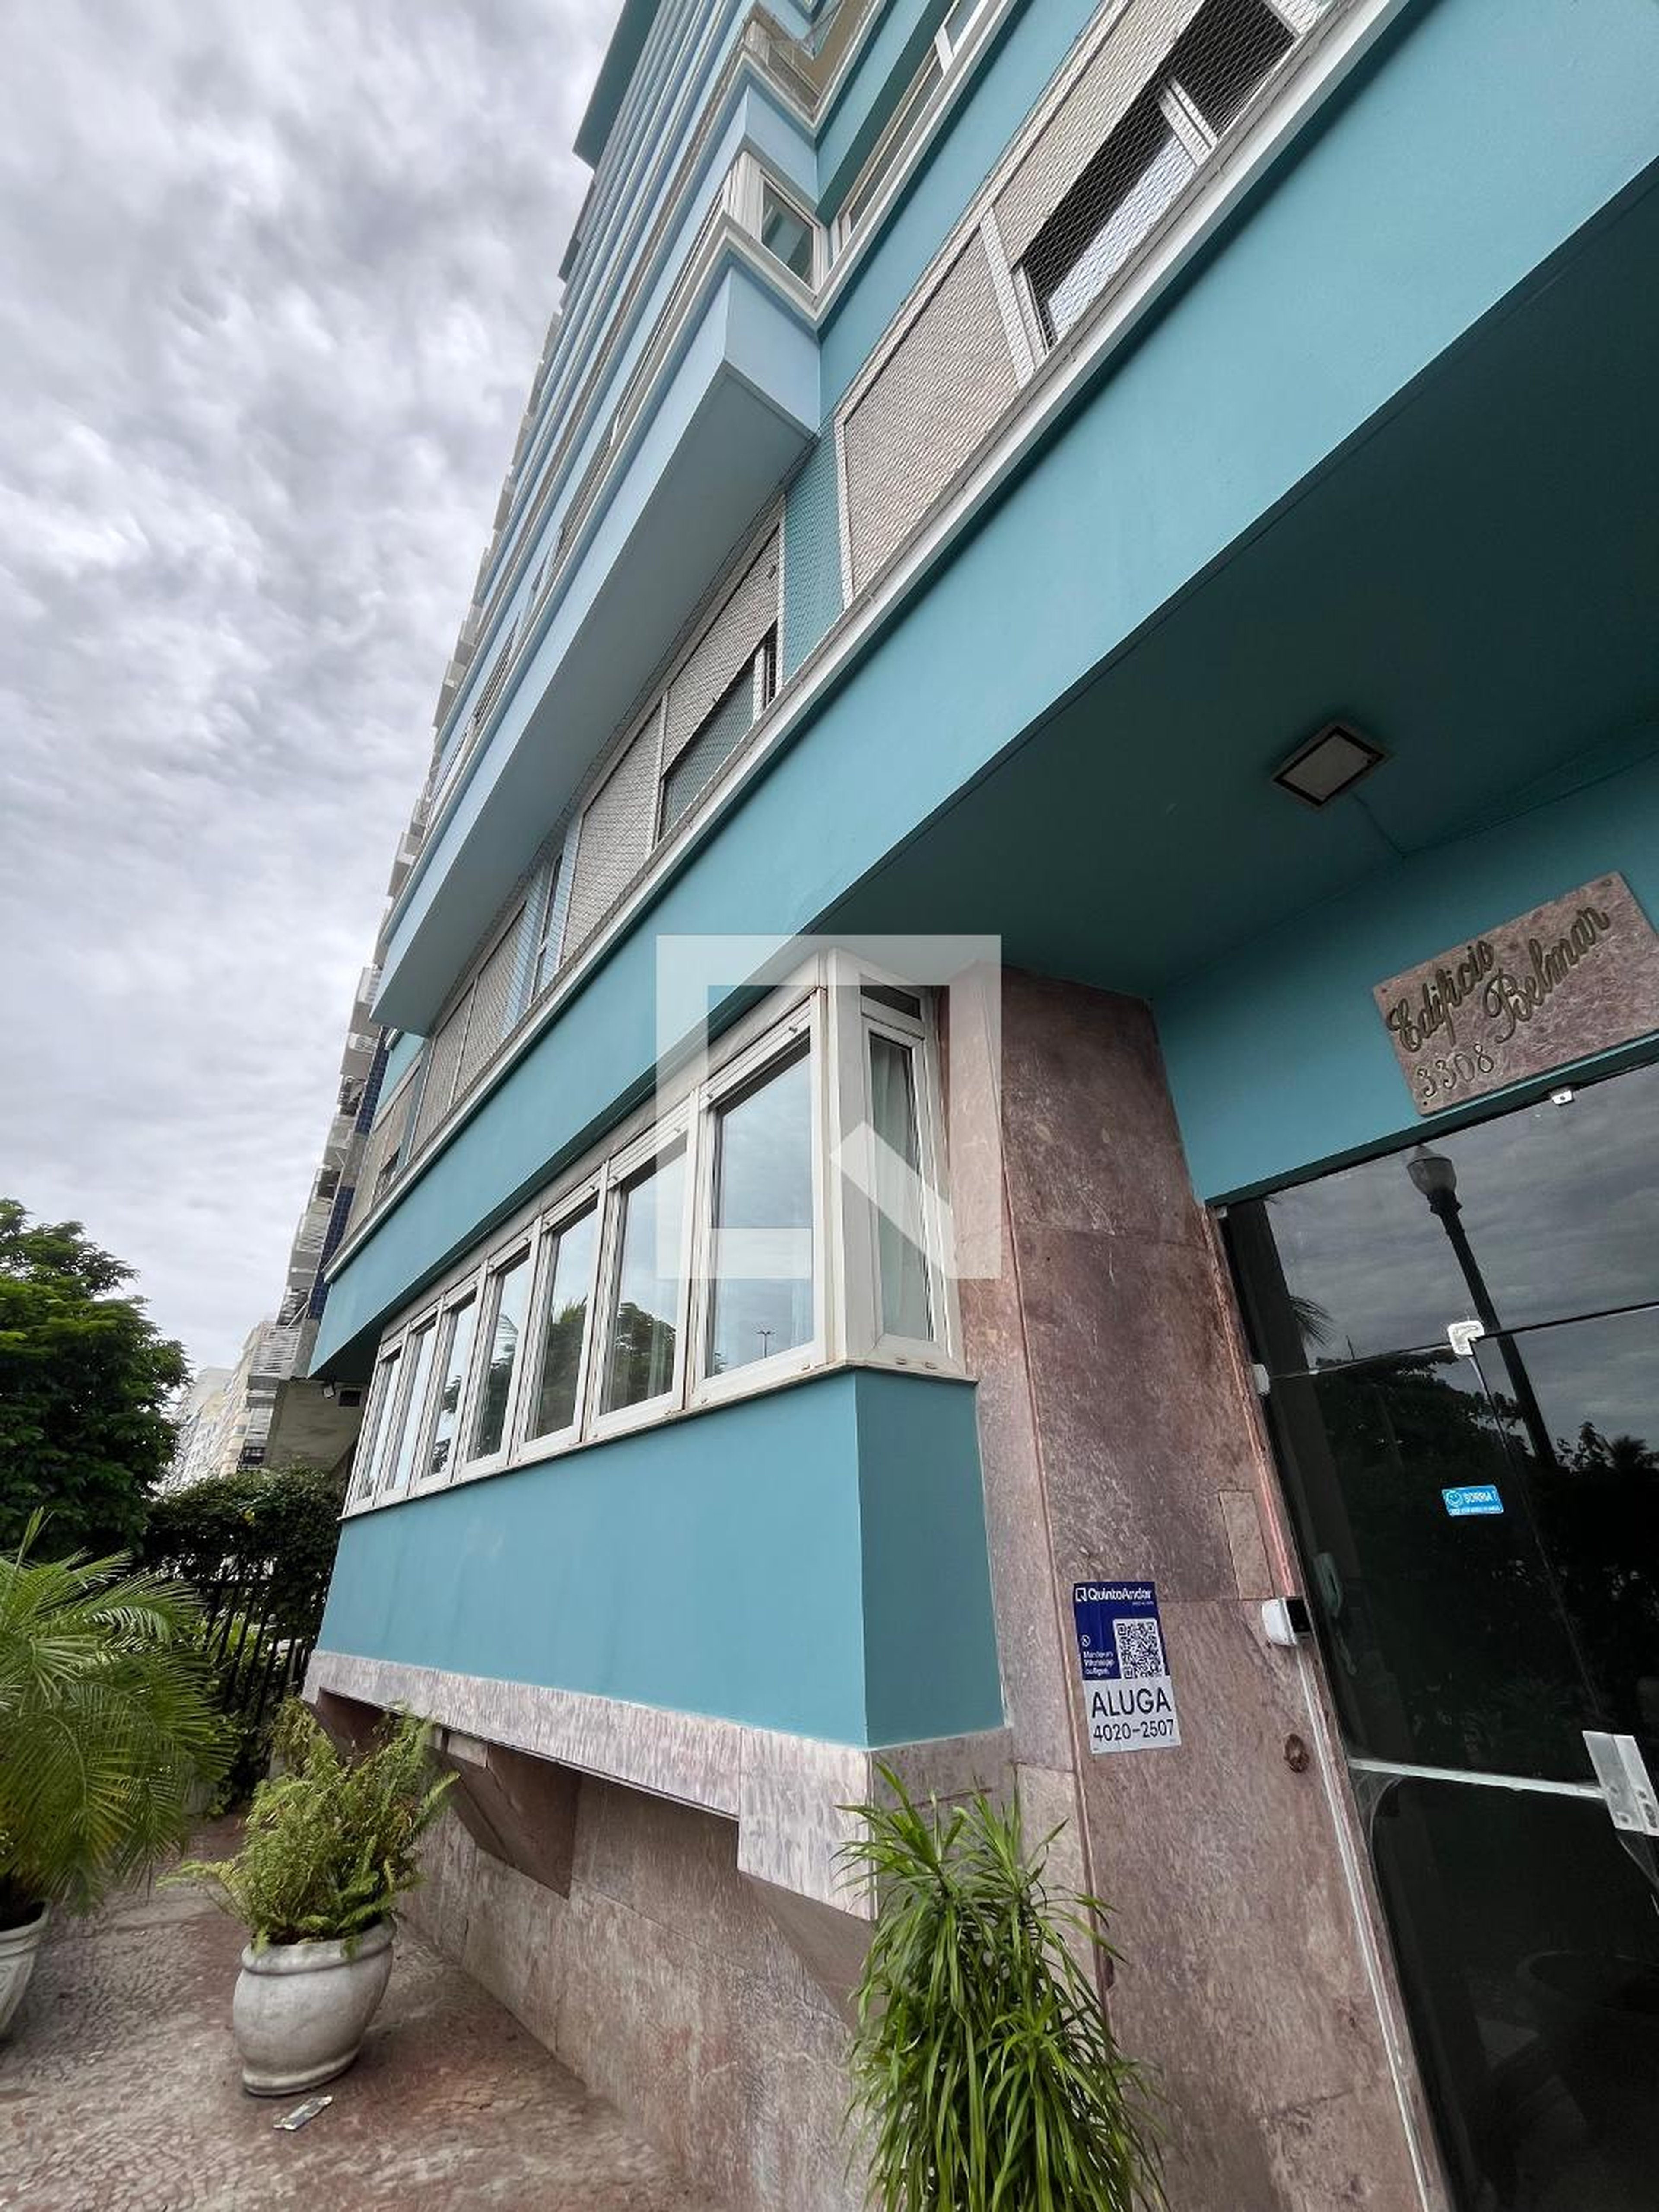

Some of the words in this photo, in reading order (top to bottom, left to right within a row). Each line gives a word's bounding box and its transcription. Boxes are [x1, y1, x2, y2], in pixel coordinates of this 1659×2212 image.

[1417, 1043, 1494, 1098] 3308
[1088, 1587, 1152, 1601] QuintoAndar
[1091, 1687, 1172, 1719] ALUGA
[1093, 1719, 1174, 1743] 4020-2507
